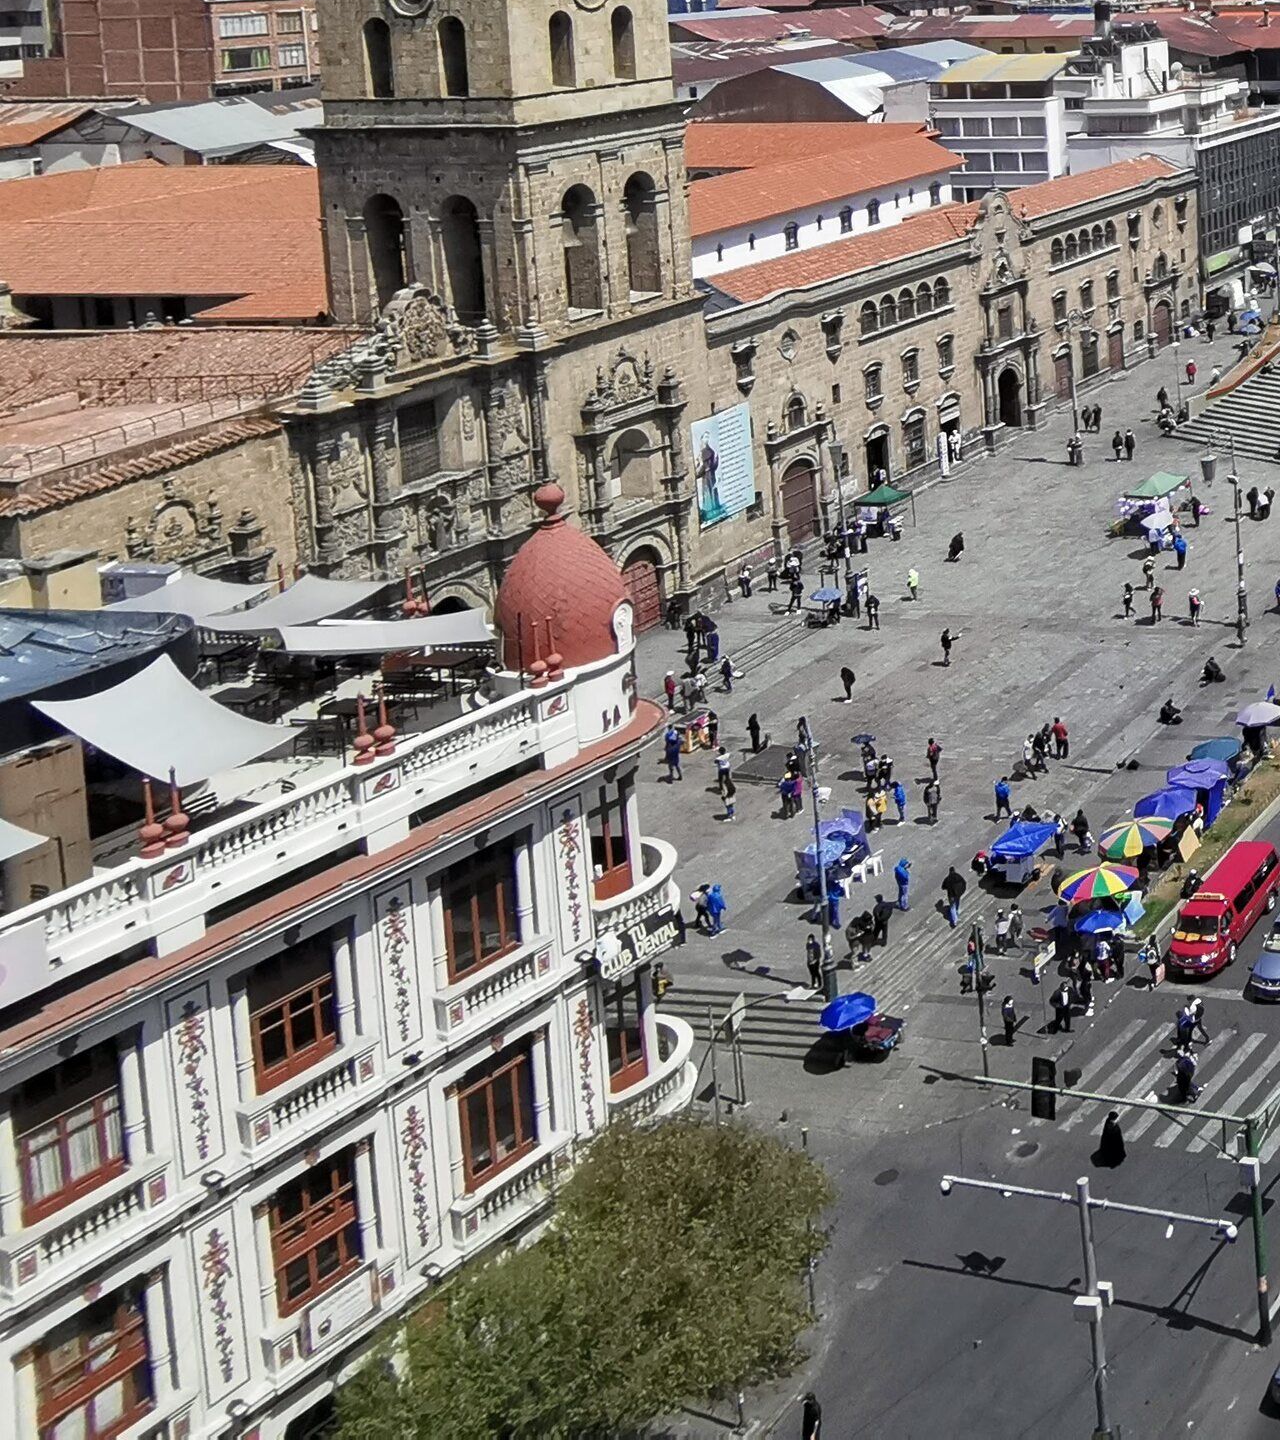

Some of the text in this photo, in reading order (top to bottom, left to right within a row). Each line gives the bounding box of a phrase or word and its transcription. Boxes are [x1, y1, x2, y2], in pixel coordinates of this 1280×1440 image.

[601, 921, 680, 979] CLUB DENTAL
[627, 922, 647, 947] TU
